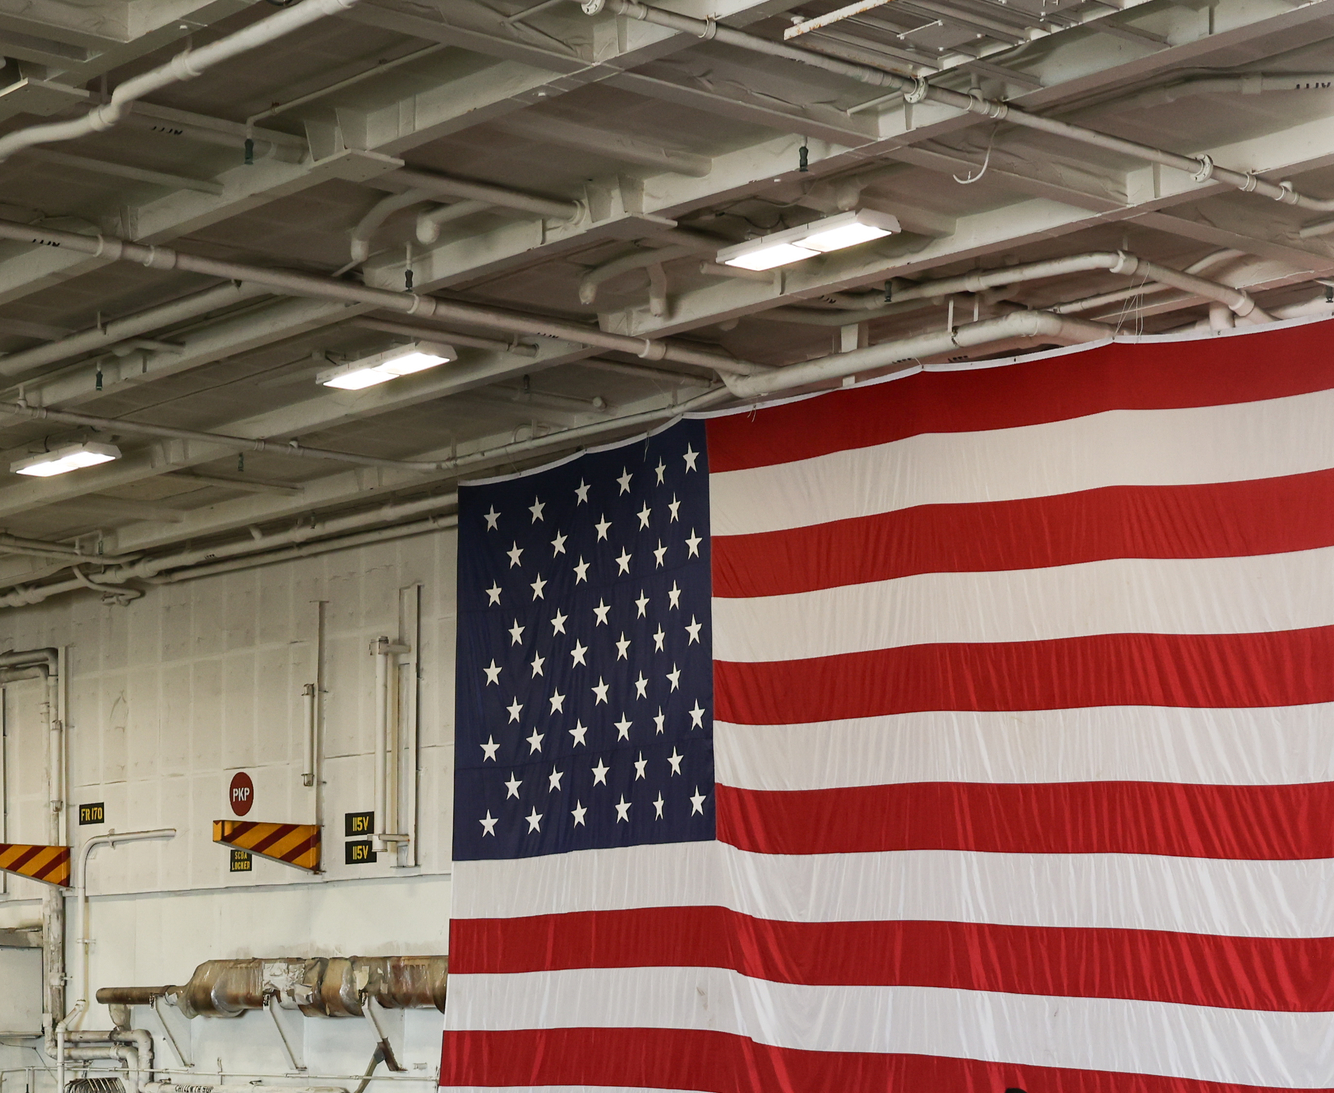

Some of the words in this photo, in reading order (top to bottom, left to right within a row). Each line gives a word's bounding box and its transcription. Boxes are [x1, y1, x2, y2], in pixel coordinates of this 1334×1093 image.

[232, 787, 250, 802] PKP
[80, 808, 90, 821] FR
[92, 807, 102, 820] 170
[352, 816, 370, 832] 115V
[352, 845, 368, 860] 115V
[232, 861, 250, 870] LOCKER
